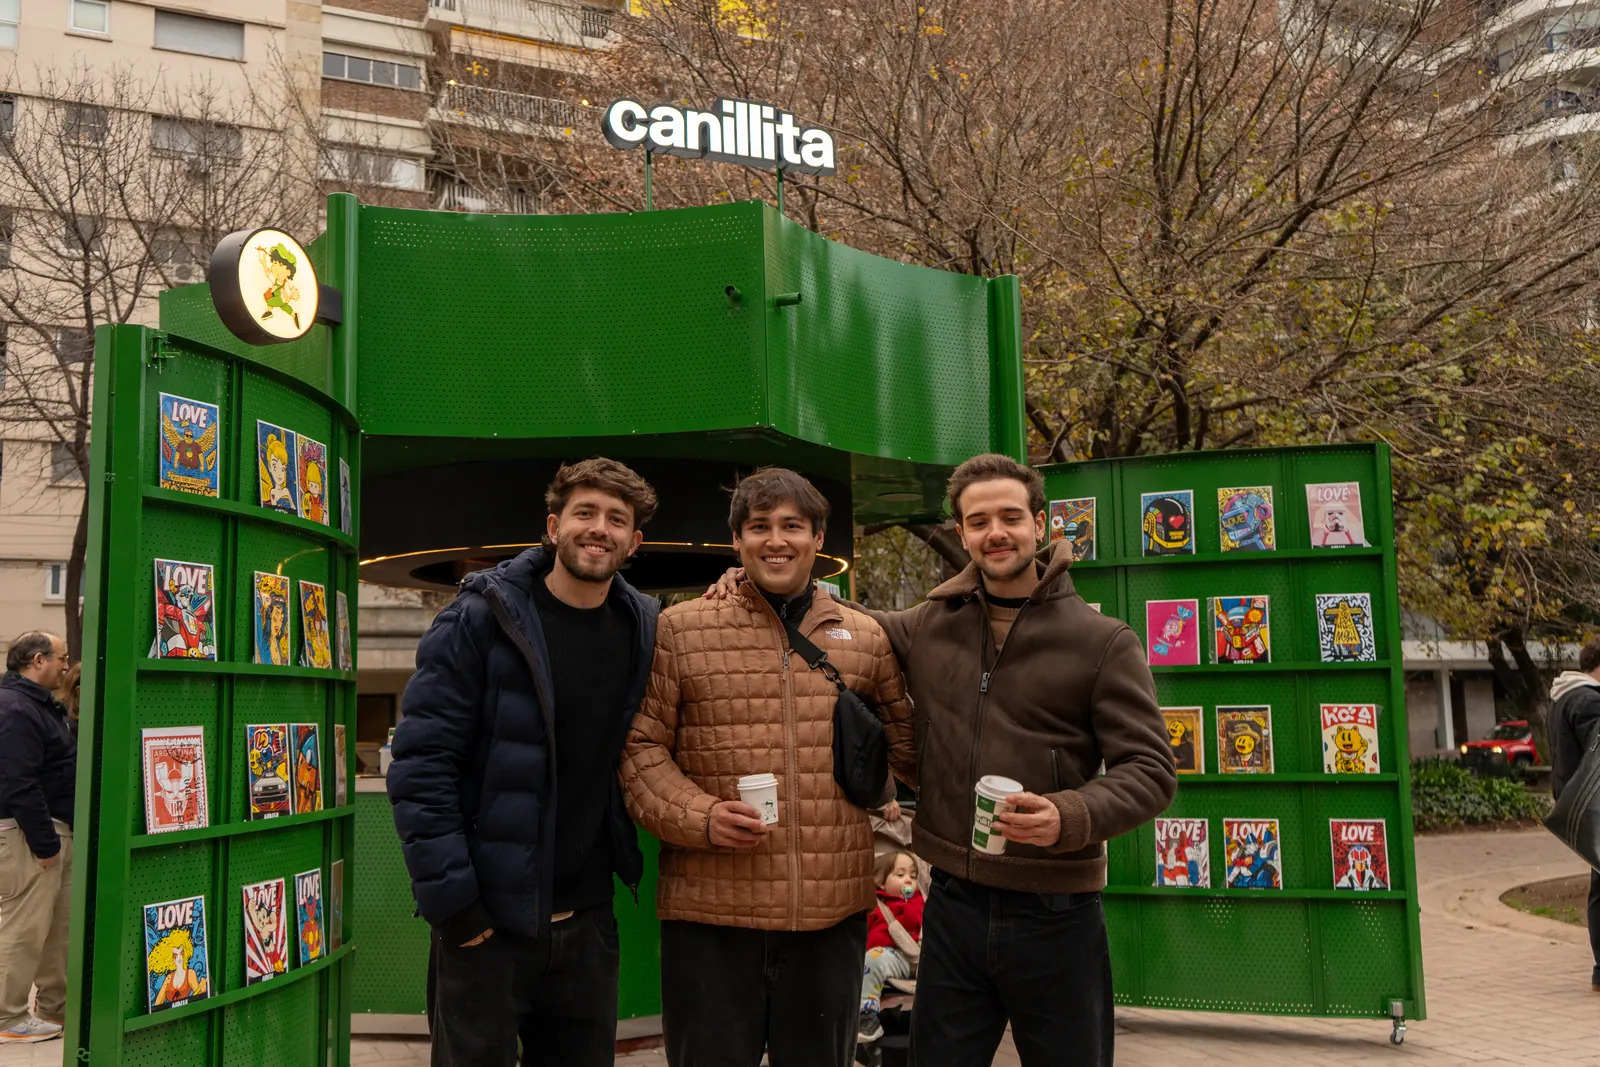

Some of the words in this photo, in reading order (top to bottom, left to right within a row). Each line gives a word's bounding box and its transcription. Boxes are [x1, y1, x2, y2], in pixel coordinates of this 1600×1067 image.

[607, 98, 836, 169] canillita
[171, 400, 208, 429] LOVE
[1317, 486, 1349, 502] LOVE
[1341, 824, 1375, 842] LOVE
[298, 873, 320, 906] LOVE
[157, 901, 194, 930] LOVE
